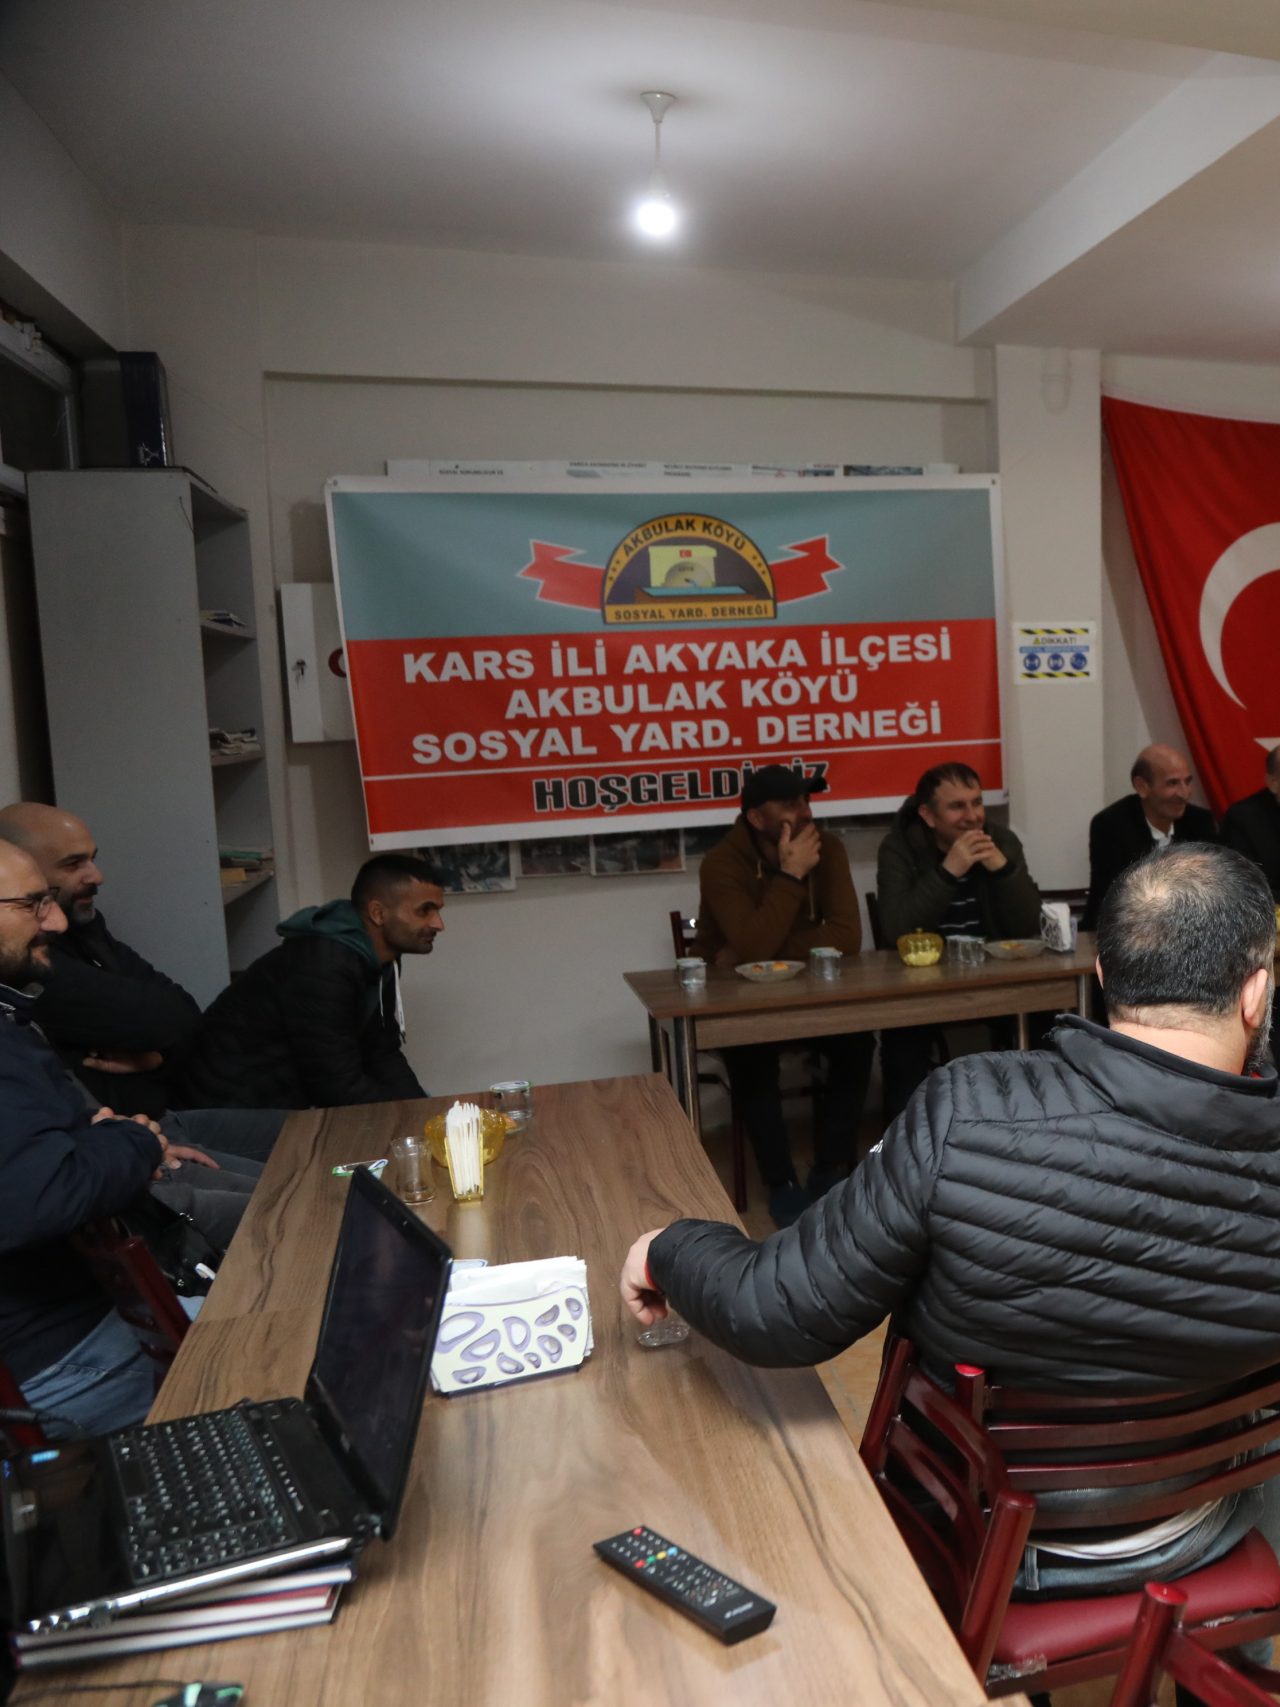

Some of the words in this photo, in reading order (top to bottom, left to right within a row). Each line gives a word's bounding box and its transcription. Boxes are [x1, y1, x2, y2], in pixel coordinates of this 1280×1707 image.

[623, 519, 697, 557] AKBULAK
[702, 520, 746, 551] KÖYÜ
[614, 608, 665, 621] SOSYAL
[670, 606, 707, 619] YARD.
[711, 603, 769, 617] DERNEĞİ
[403, 648, 535, 684] KARS
[551, 639, 608, 678] İLİ
[623, 639, 808, 675] AKYAKA
[820, 627, 952, 672] İLÇESİ
[504, 680, 728, 720] AKBULAK
[741, 668, 859, 708] KÖYÜ
[412, 726, 598, 765] SOSYAL
[609, 718, 743, 753] YARD.
[757, 701, 942, 746] DERNEĞİ
